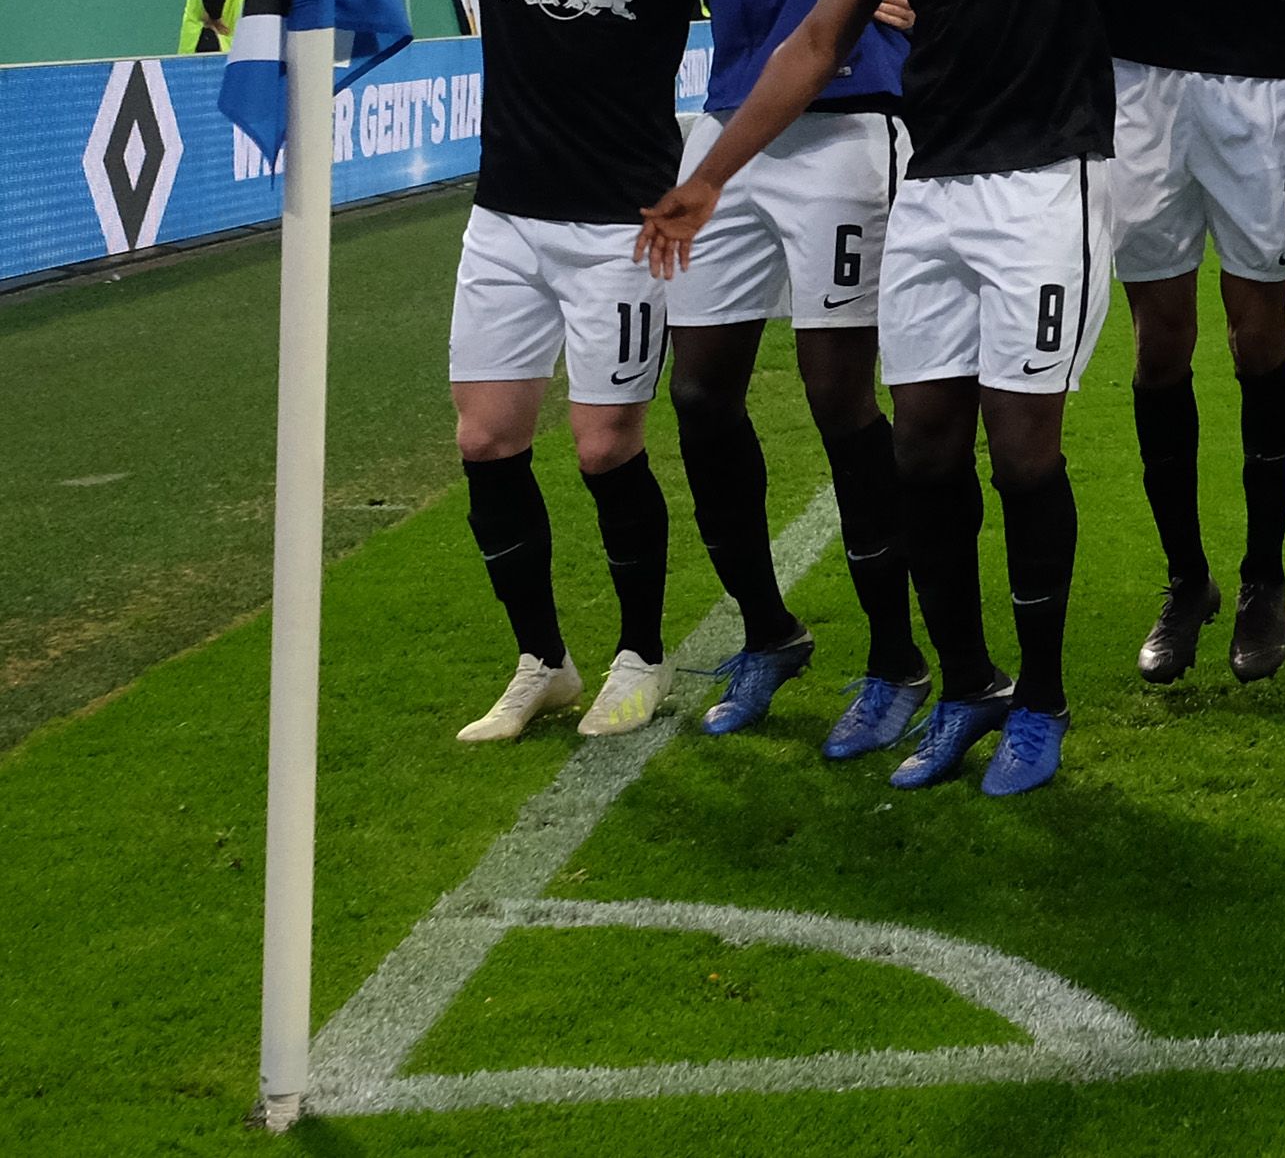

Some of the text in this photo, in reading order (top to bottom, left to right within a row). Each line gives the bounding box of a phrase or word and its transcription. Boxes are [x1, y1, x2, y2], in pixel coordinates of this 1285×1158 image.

[360, 77, 447, 158] GEHT'S
[450, 73, 482, 142] HA
[833, 223, 863, 287] 6
[617, 301, 652, 364] 11
[1035, 283, 1066, 353] 8
